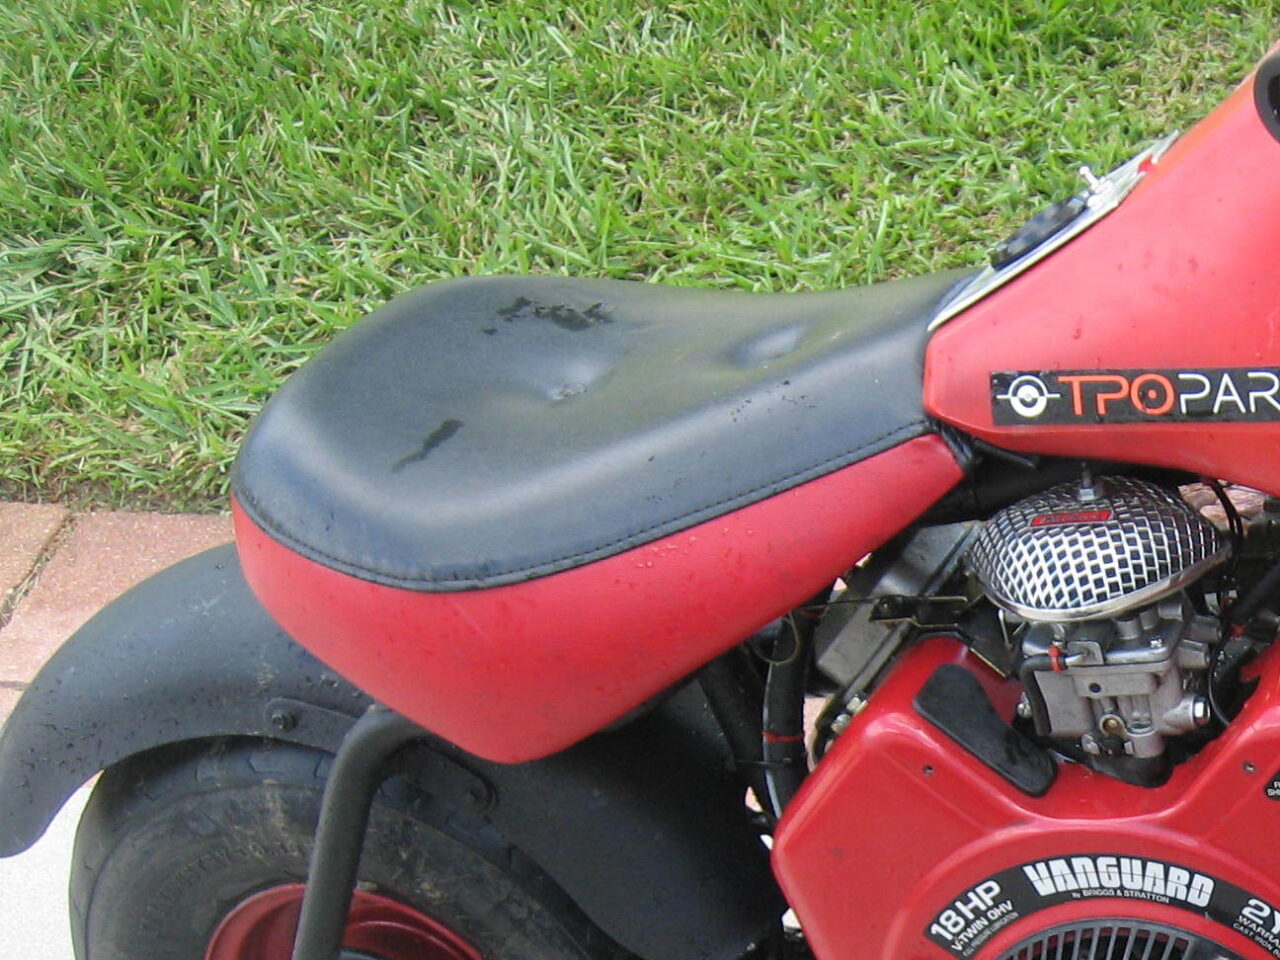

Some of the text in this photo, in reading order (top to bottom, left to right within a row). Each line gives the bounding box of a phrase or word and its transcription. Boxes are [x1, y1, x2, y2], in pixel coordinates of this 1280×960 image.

[1023, 856, 1215, 908] VANGUARD
[1082, 888, 1115, 897] BRIGGS
[1116, 889, 1123, 897] &
[1123, 889, 1170, 904] STRATTON
[951, 916, 989, 951] V-TWIN
[986, 900, 1013, 920] OHV
[1232, 922, 1255, 937] CAST
